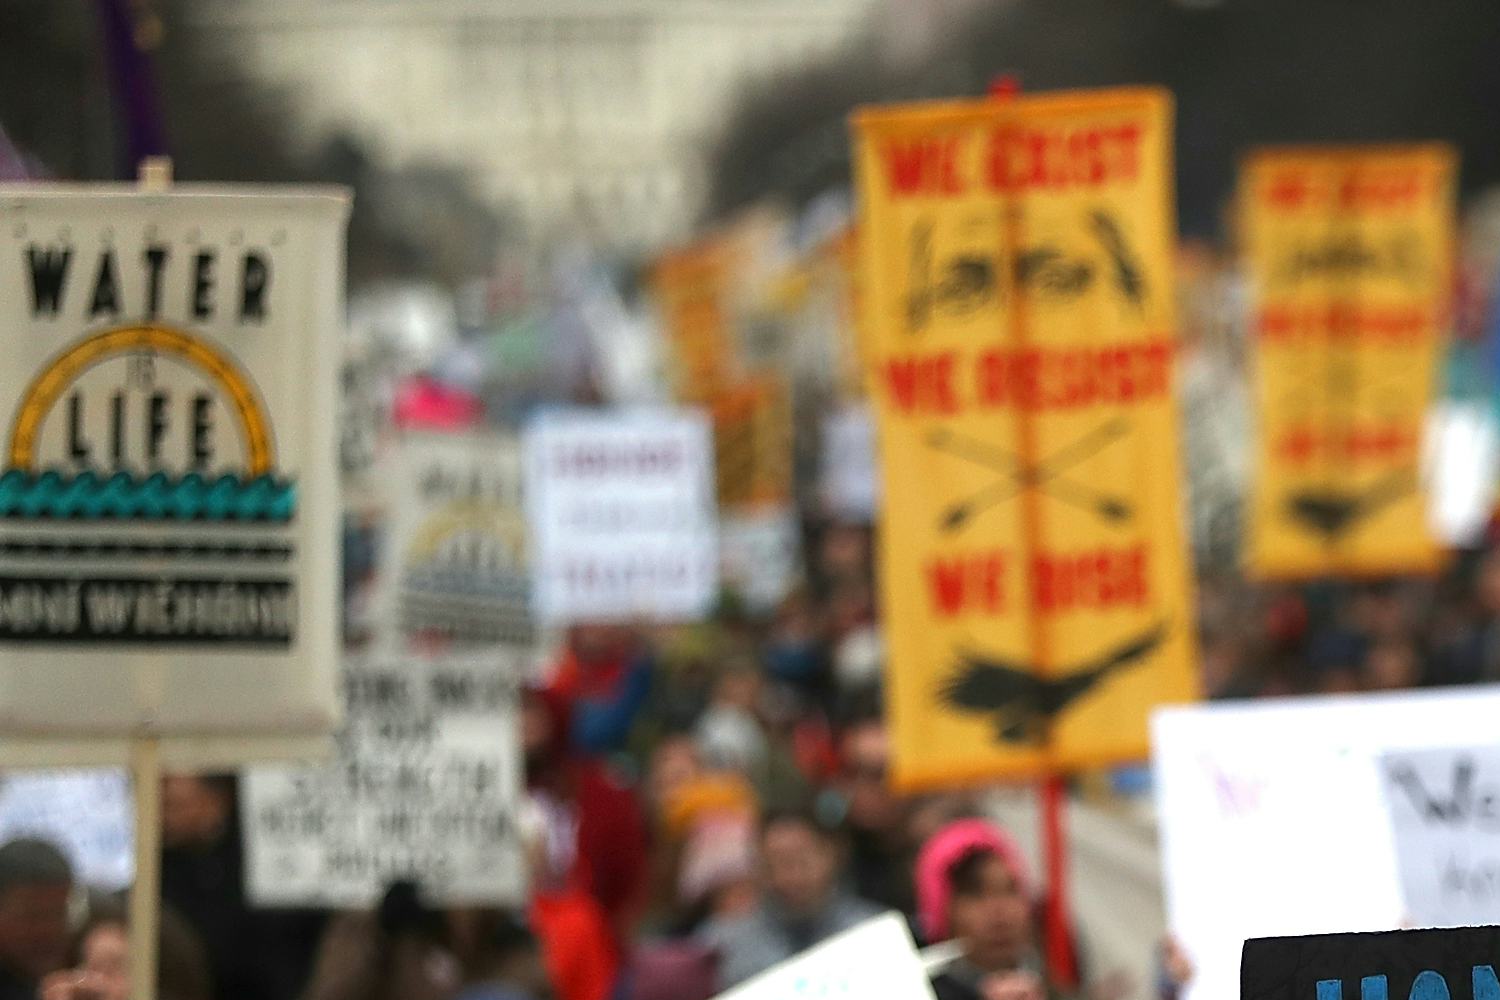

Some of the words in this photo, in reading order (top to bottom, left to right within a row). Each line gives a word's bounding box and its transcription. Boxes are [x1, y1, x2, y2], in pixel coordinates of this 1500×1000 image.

[26, 243, 275, 325] WATER
[67, 390, 216, 467] LIFE
[926, 548, 1008, 617] WE
